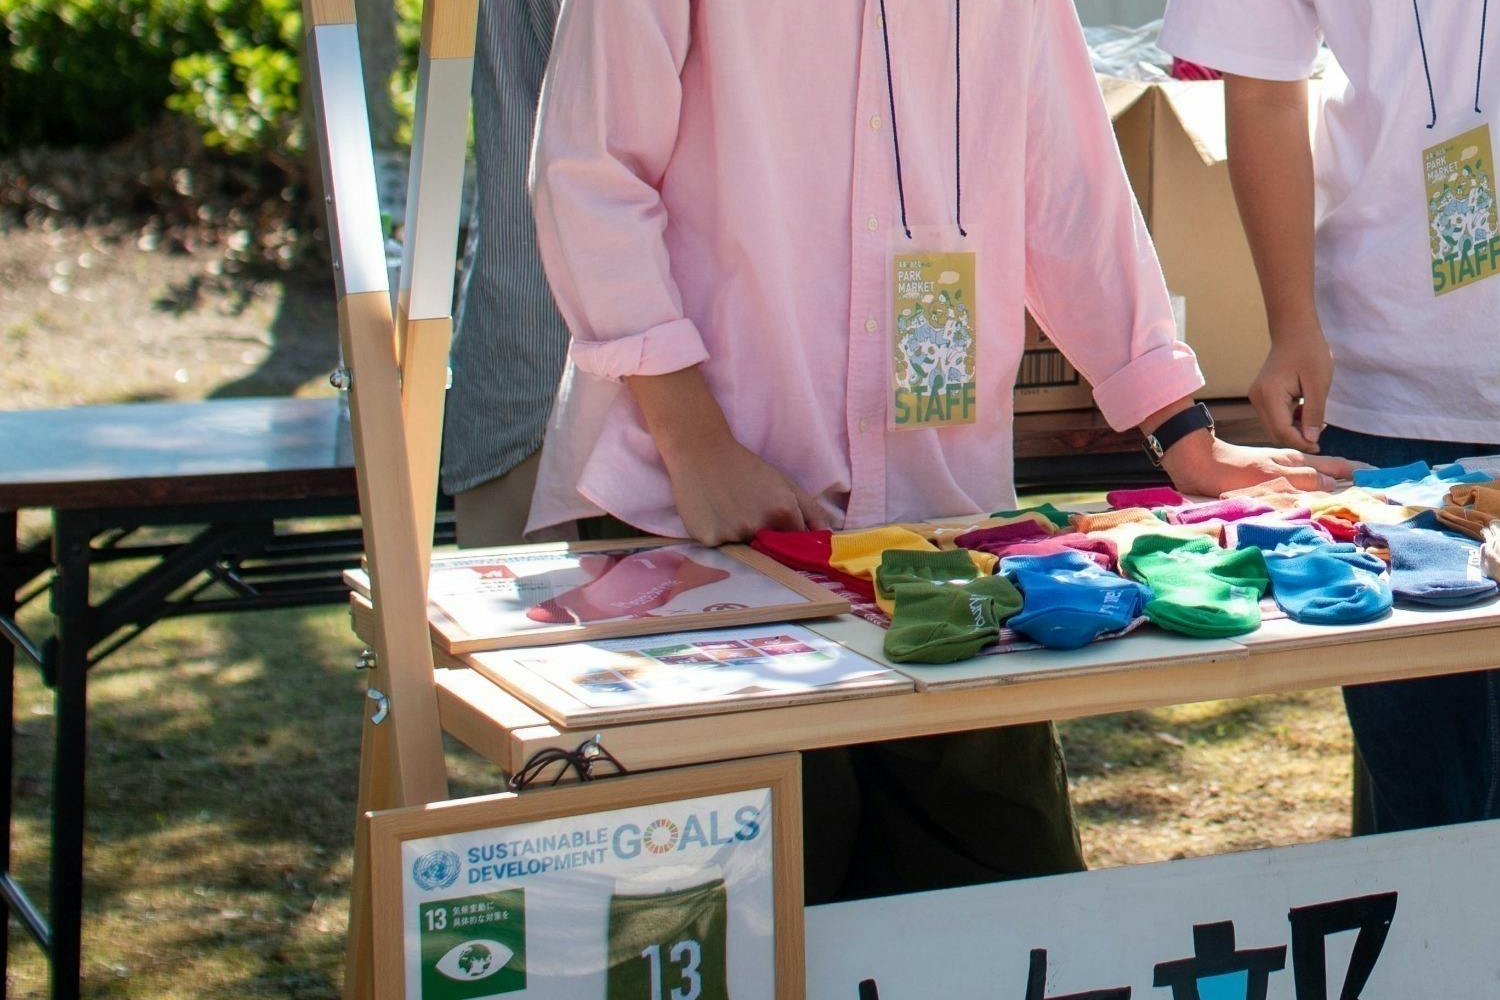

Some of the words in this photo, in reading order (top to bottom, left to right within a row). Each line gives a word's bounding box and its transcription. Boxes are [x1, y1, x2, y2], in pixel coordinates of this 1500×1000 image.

[898, 270, 922, 283] PARK
[898, 281, 936, 294] MARKET
[895, 382, 976, 425] STAFF
[467, 826, 609, 864] SUSTAINABLE
[612, 805, 761, 860] GOALS
[467, 848, 607, 885] DEVELOPMENT
[425, 906, 448, 932] 13
[641, 939, 703, 1000] 13
